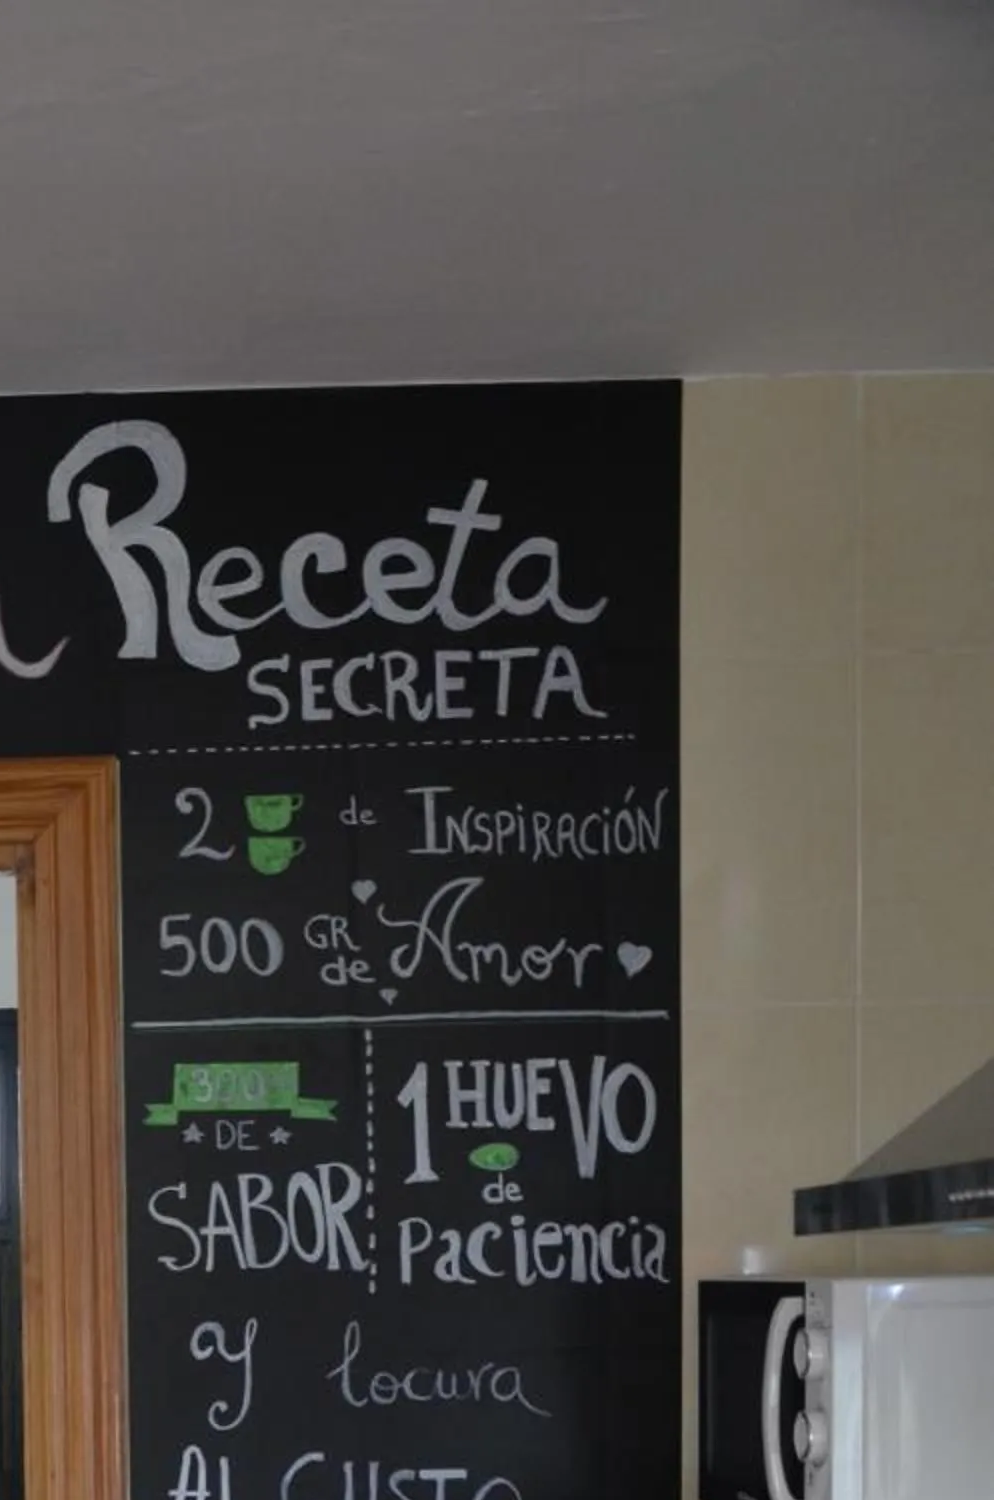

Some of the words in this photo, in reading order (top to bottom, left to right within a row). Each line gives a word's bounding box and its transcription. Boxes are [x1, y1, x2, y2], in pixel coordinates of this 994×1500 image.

[47, 418, 609, 673] Receta
[246, 645, 608, 730] SECRETA
[174, 787, 235, 861] 2
[339, 795, 378, 826] de
[159, 913, 284, 978] 500
[303, 914, 355, 951] GR
[377, 876, 603, 986] Amor
[320, 956, 376, 987] de
[214, 1119, 260, 1151] DE
[396, 1061, 440, 1185] 1
[442, 1055, 658, 1180] HUEVO
[148, 1162, 369, 1274] SABOR
[480, 1171, 524, 1205] de
[397, 1214, 671, 1287] Paciencia
[325, 1320, 553, 1418] locura
